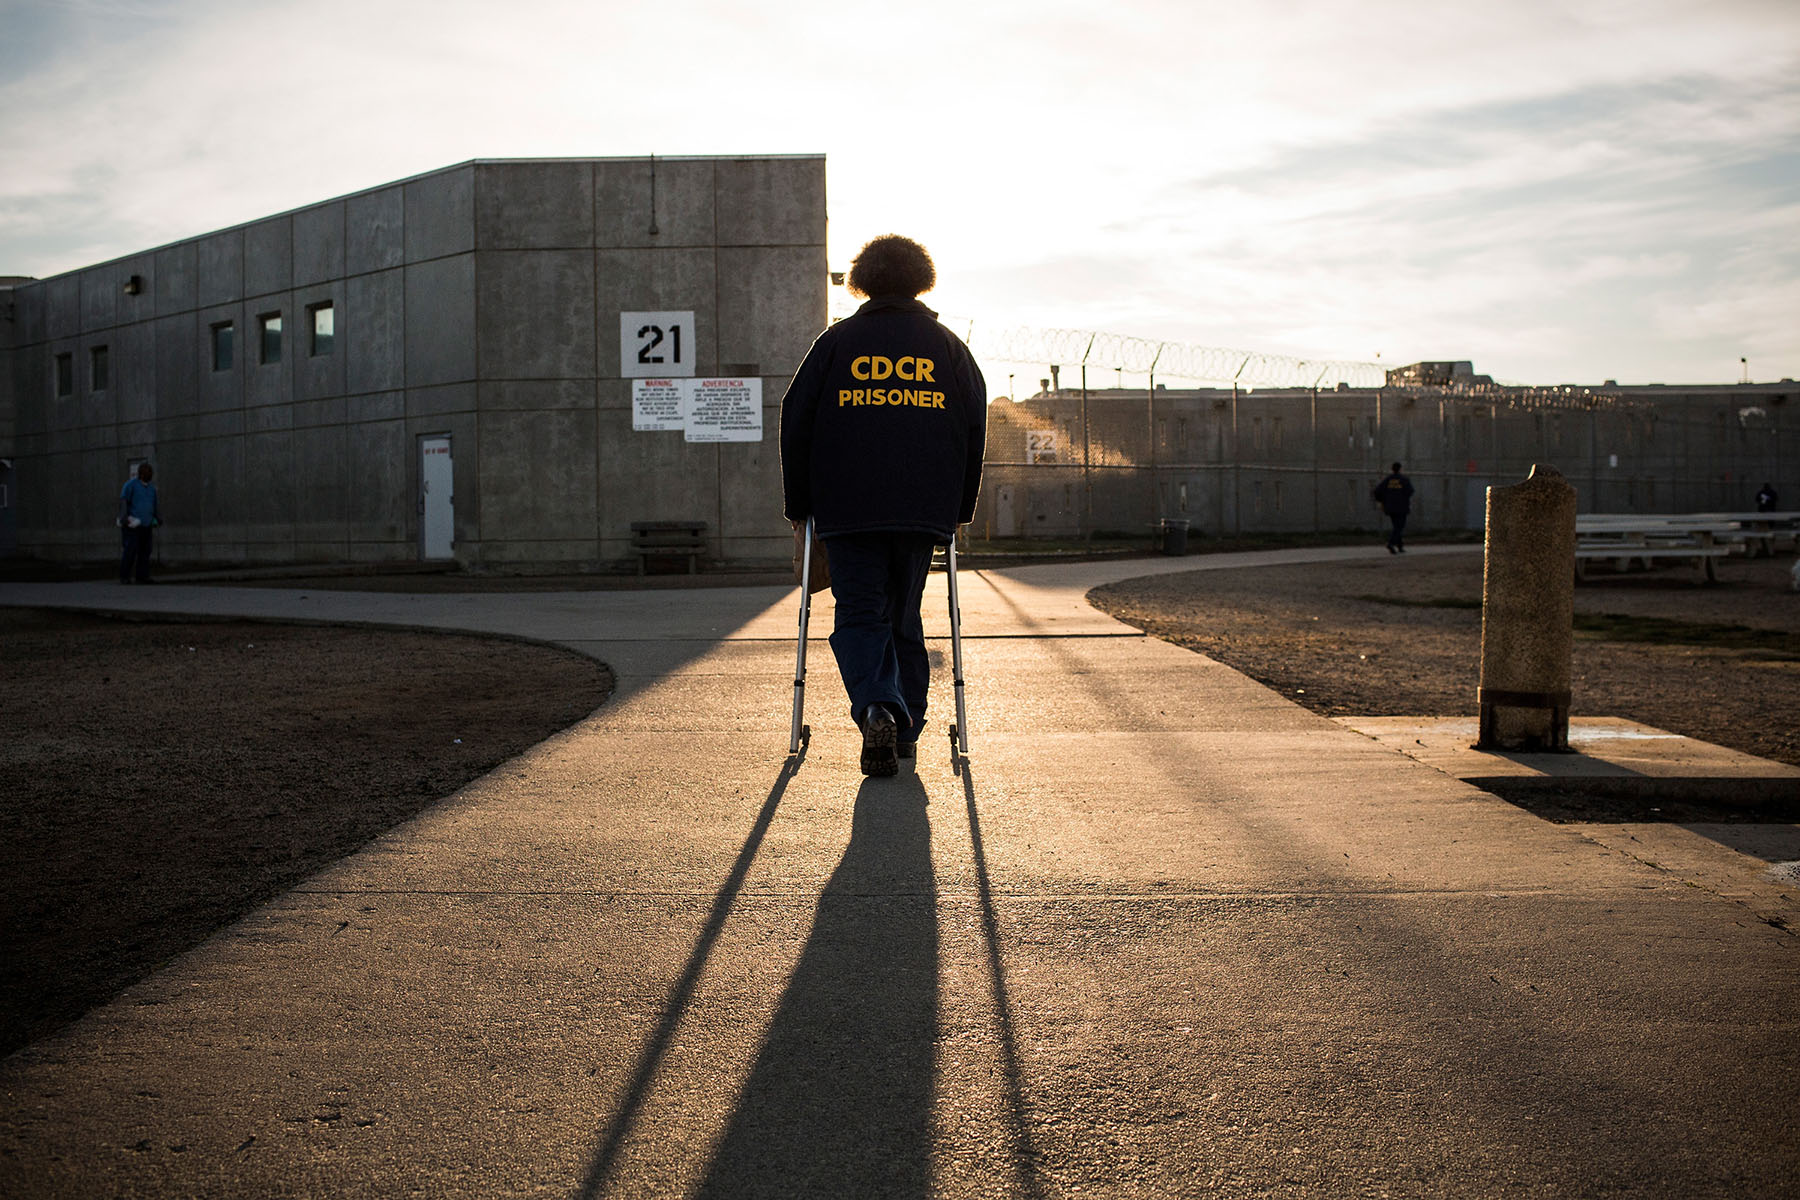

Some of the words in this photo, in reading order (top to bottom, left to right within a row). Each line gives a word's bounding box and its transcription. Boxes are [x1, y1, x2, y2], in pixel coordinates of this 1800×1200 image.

[637, 325, 681, 364] 21
[850, 355, 936, 383] CDCR
[839, 388, 946, 409] PRISONER
[1030, 434, 1053, 450] 22
